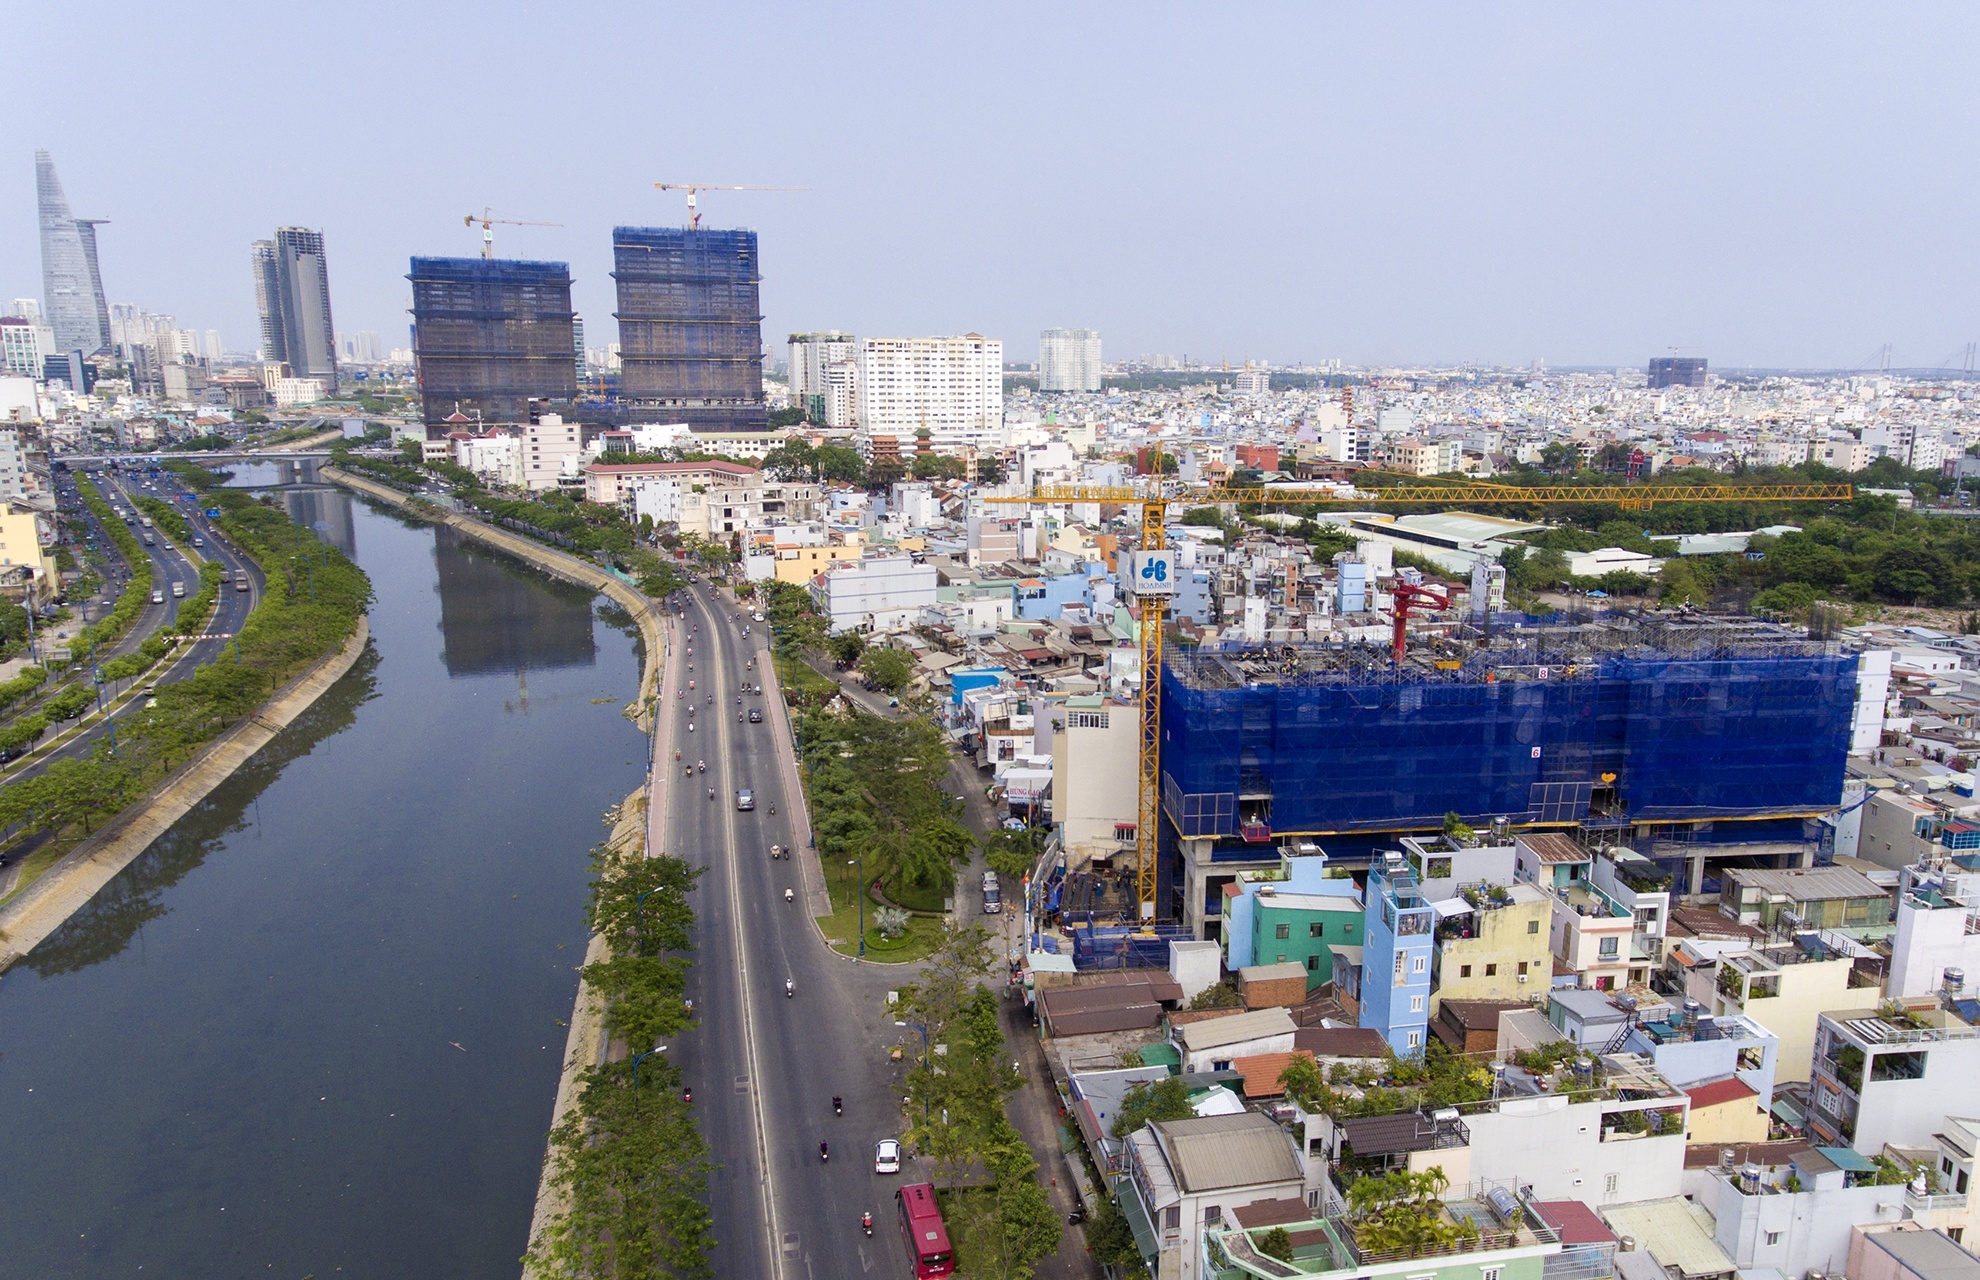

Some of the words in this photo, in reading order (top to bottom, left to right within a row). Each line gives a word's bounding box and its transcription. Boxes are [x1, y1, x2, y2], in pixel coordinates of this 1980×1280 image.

[1038, 486, 1074, 498] GRAND
[1079, 486, 1134, 499] RIVERSIDE
[1540, 670, 1546, 678] 8
[1533, 749, 1539, 758] 6
